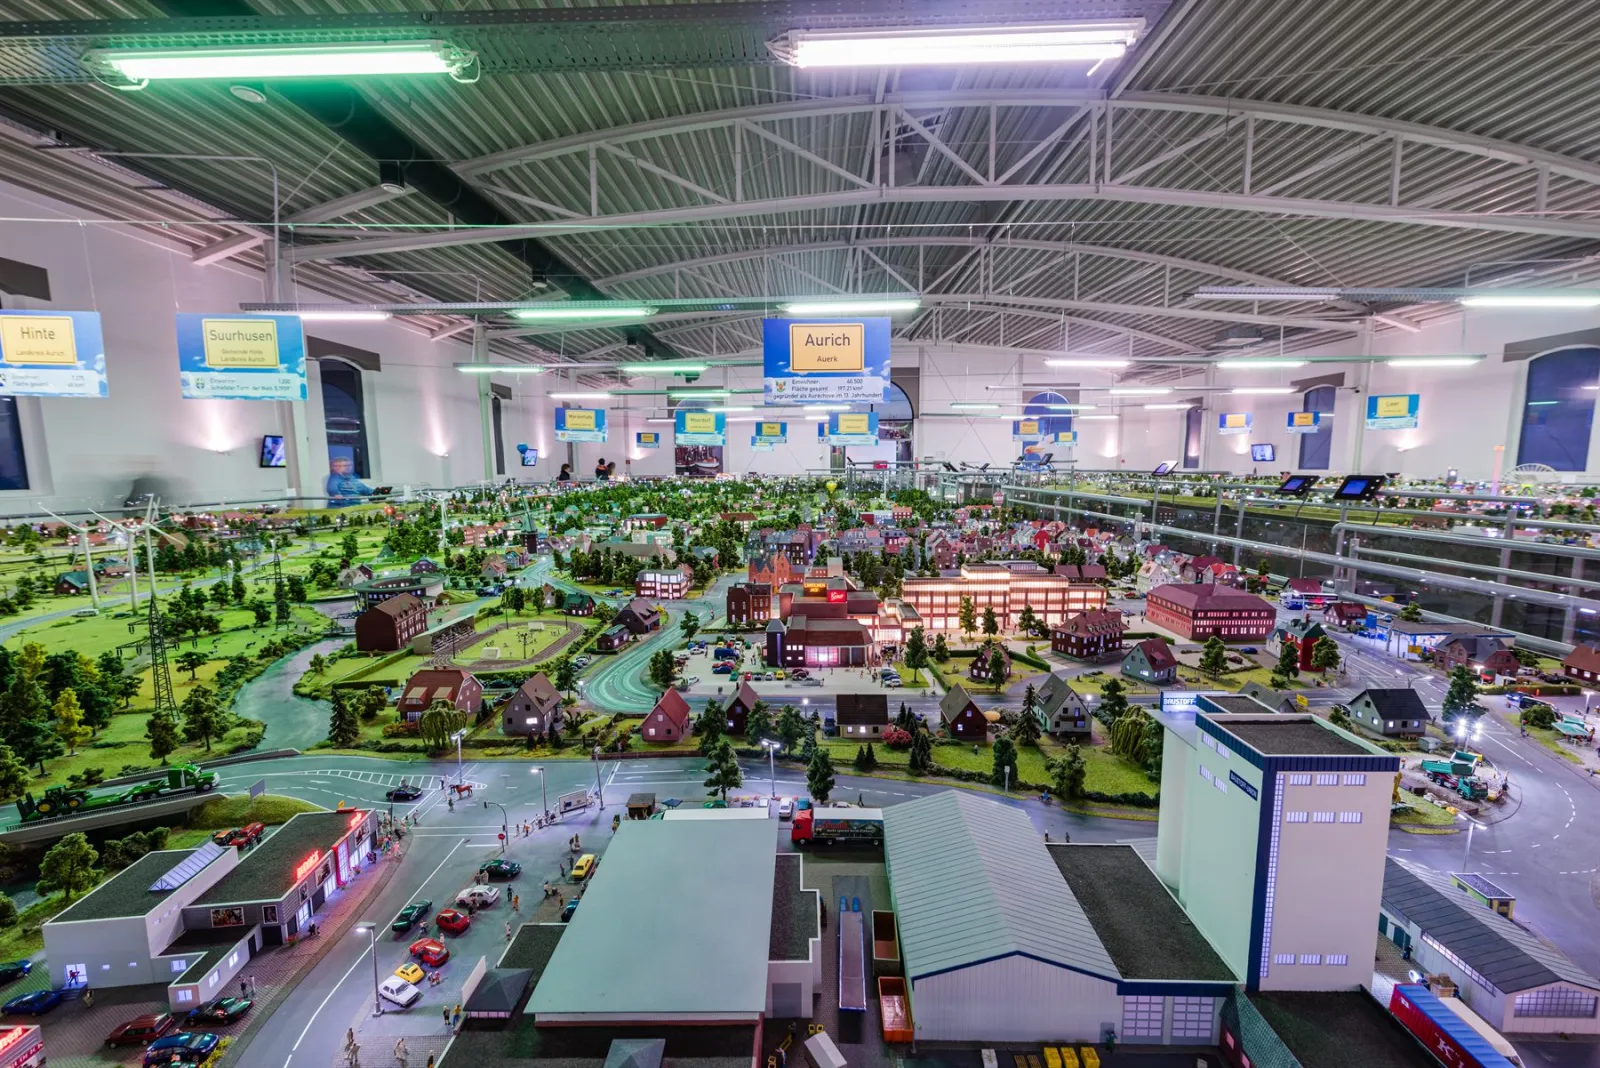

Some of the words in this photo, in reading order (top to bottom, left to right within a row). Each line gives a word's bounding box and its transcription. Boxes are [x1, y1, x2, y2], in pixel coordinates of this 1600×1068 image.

[20, 326, 56, 340] Hinte
[209, 329, 273, 341] Suurhusen
[805, 333, 851, 346] Aurich
